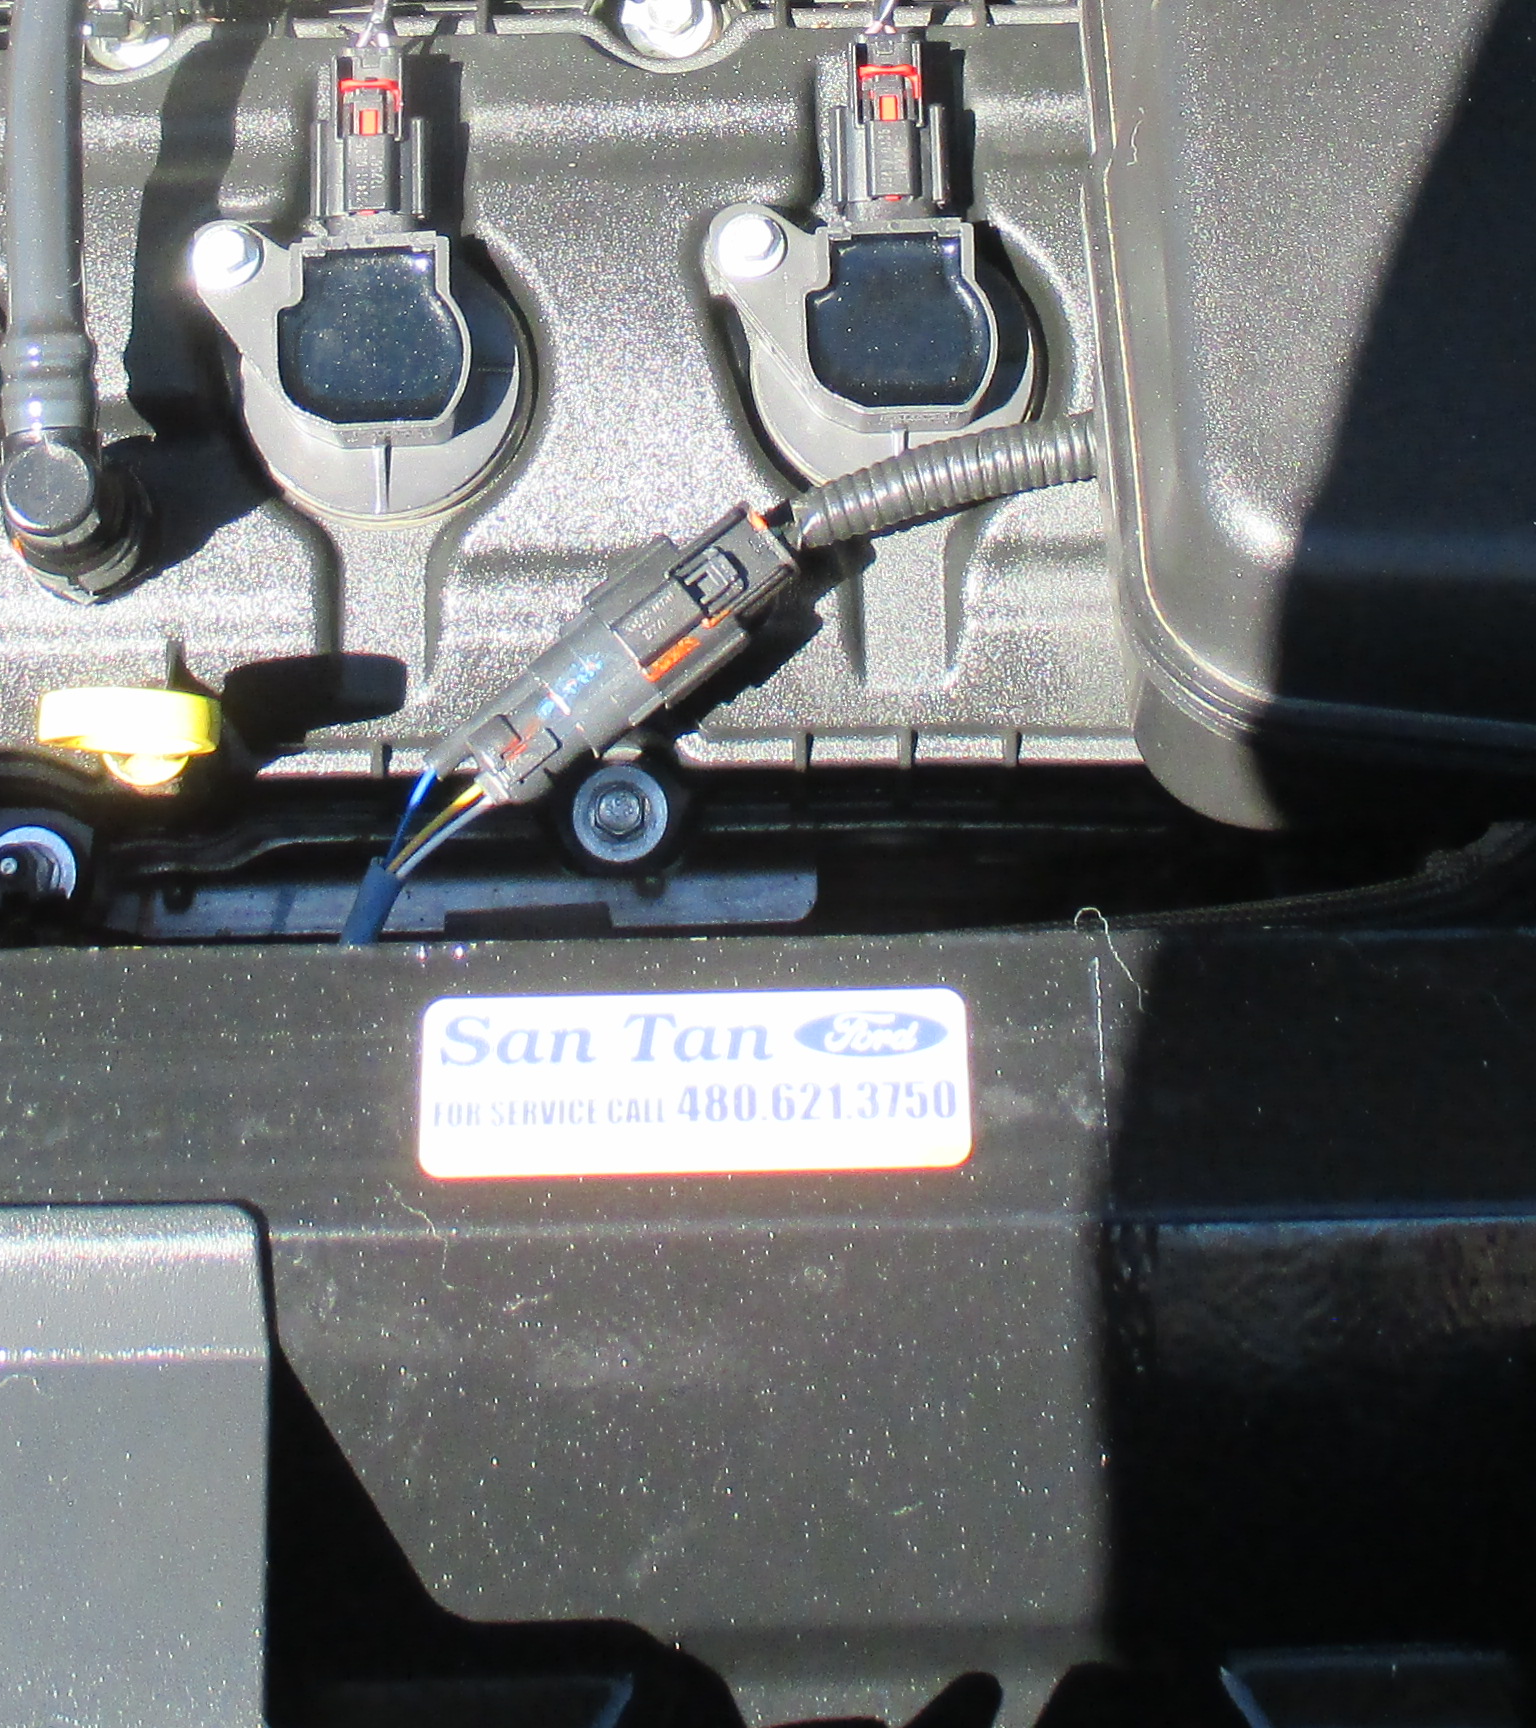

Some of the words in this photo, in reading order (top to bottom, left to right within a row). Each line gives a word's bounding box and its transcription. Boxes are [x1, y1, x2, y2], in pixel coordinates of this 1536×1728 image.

[439, 1013, 596, 1069] San
[623, 1012, 775, 1064] Tan
[822, 1009, 920, 1056] Ford
[433, 1101, 483, 1128] FOR
[491, 1097, 598, 1128] SERVICE
[606, 1095, 666, 1125] CALL
[676, 1080, 958, 1124] 480.621.3750
